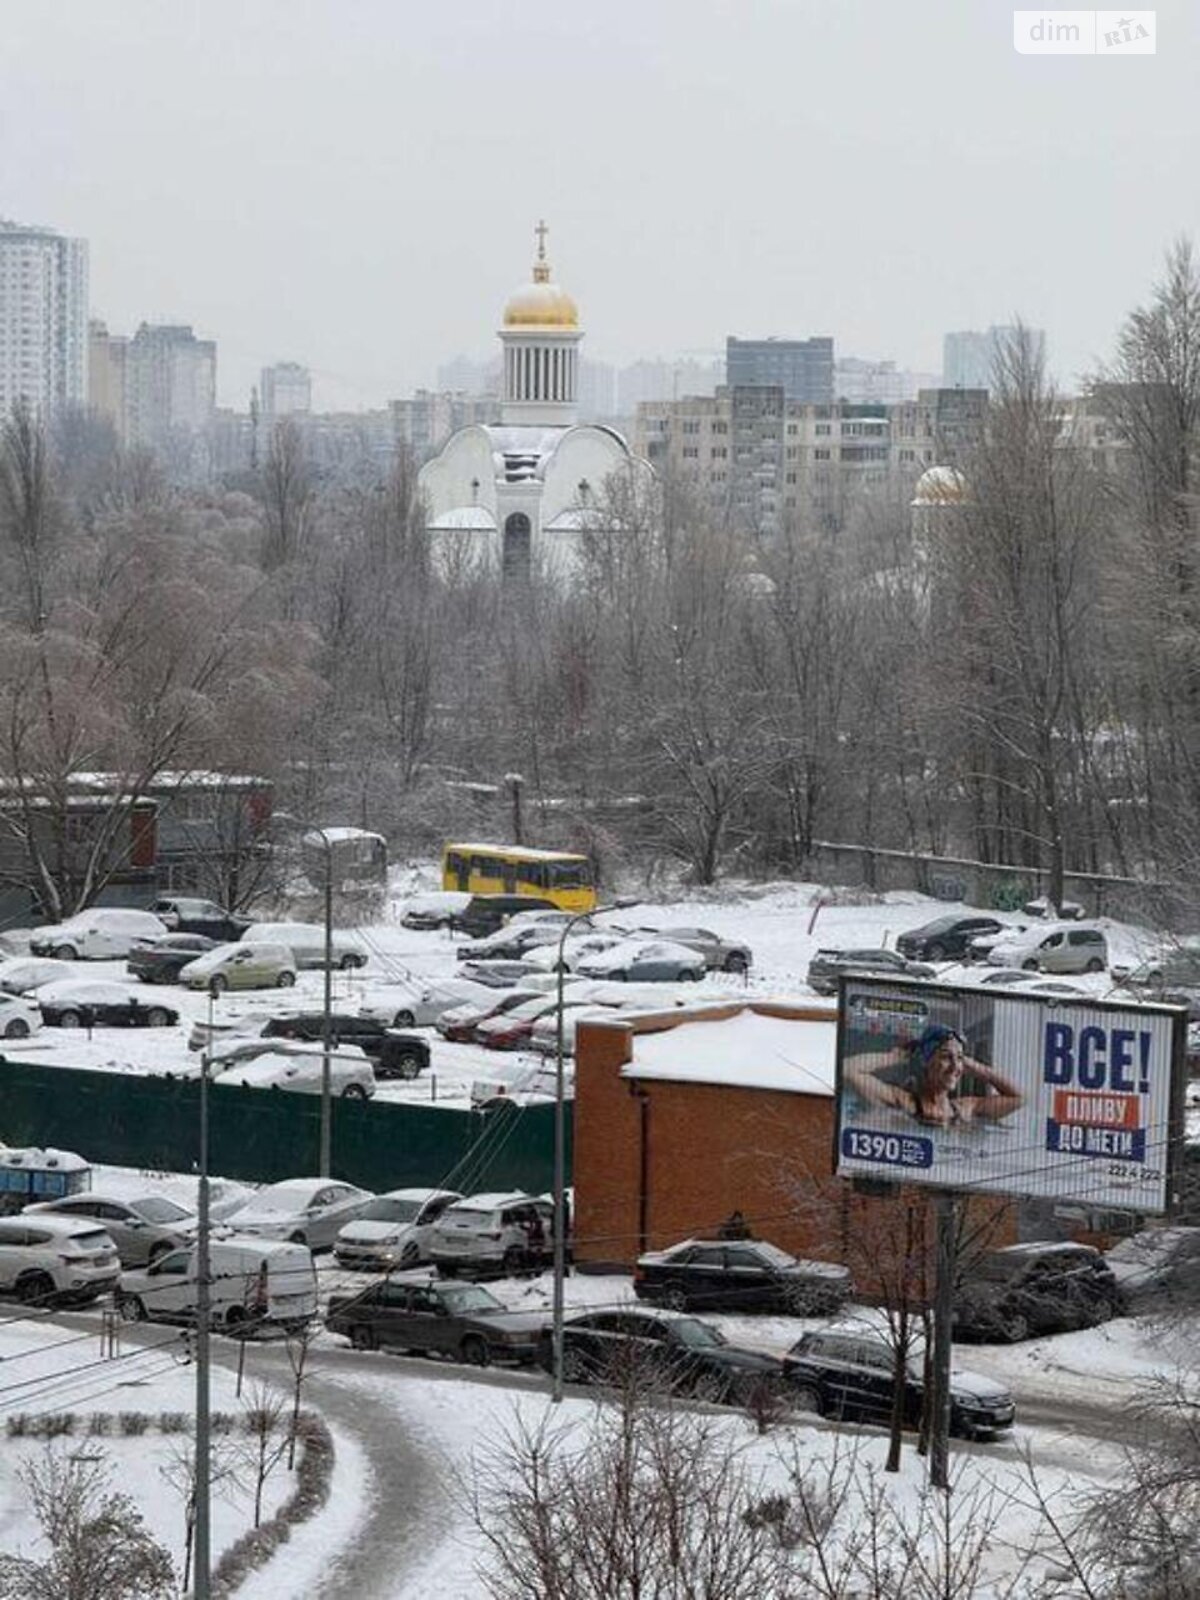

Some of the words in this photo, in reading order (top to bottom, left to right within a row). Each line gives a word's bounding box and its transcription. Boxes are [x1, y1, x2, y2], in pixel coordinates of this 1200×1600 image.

[1044, 1022, 1152, 1093] ВСЕ!
[1066, 1095, 1127, 1123] ПЛИВУ
[850, 1132, 899, 1160] 1390
[1058, 1123, 1083, 1151] ДО
[1085, 1127, 1132, 1156] МЕТИ
